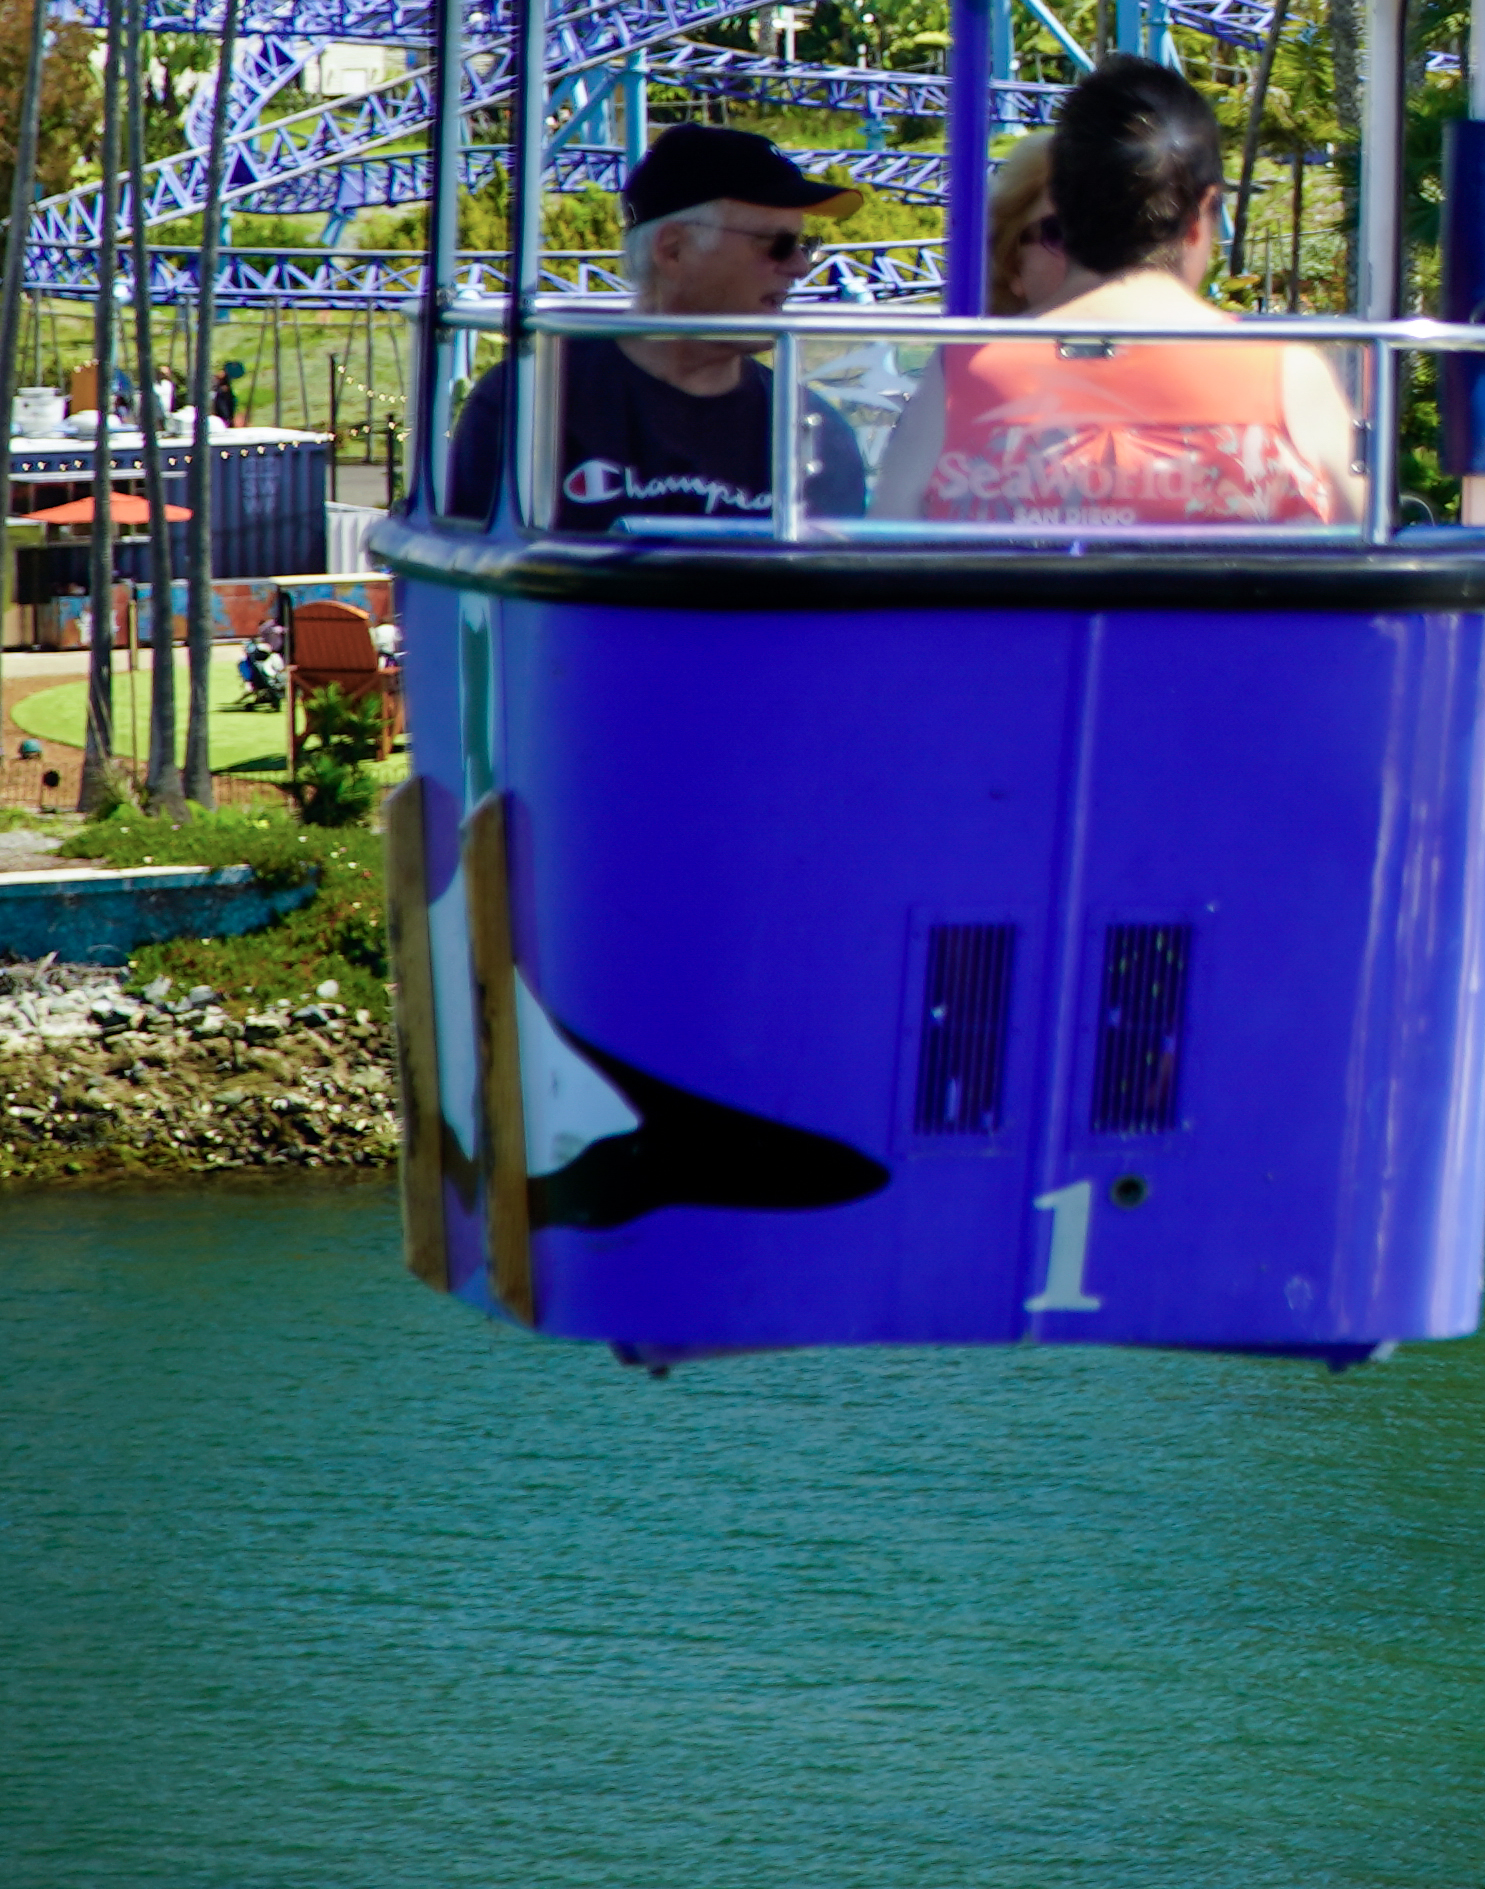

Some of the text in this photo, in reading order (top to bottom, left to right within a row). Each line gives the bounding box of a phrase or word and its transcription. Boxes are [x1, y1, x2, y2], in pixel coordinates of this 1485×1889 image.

[563, 459, 772, 514] Champio
[1013, 507, 1137, 526] SAN DIEGO
[1024, 1179, 1101, 1312] 1
